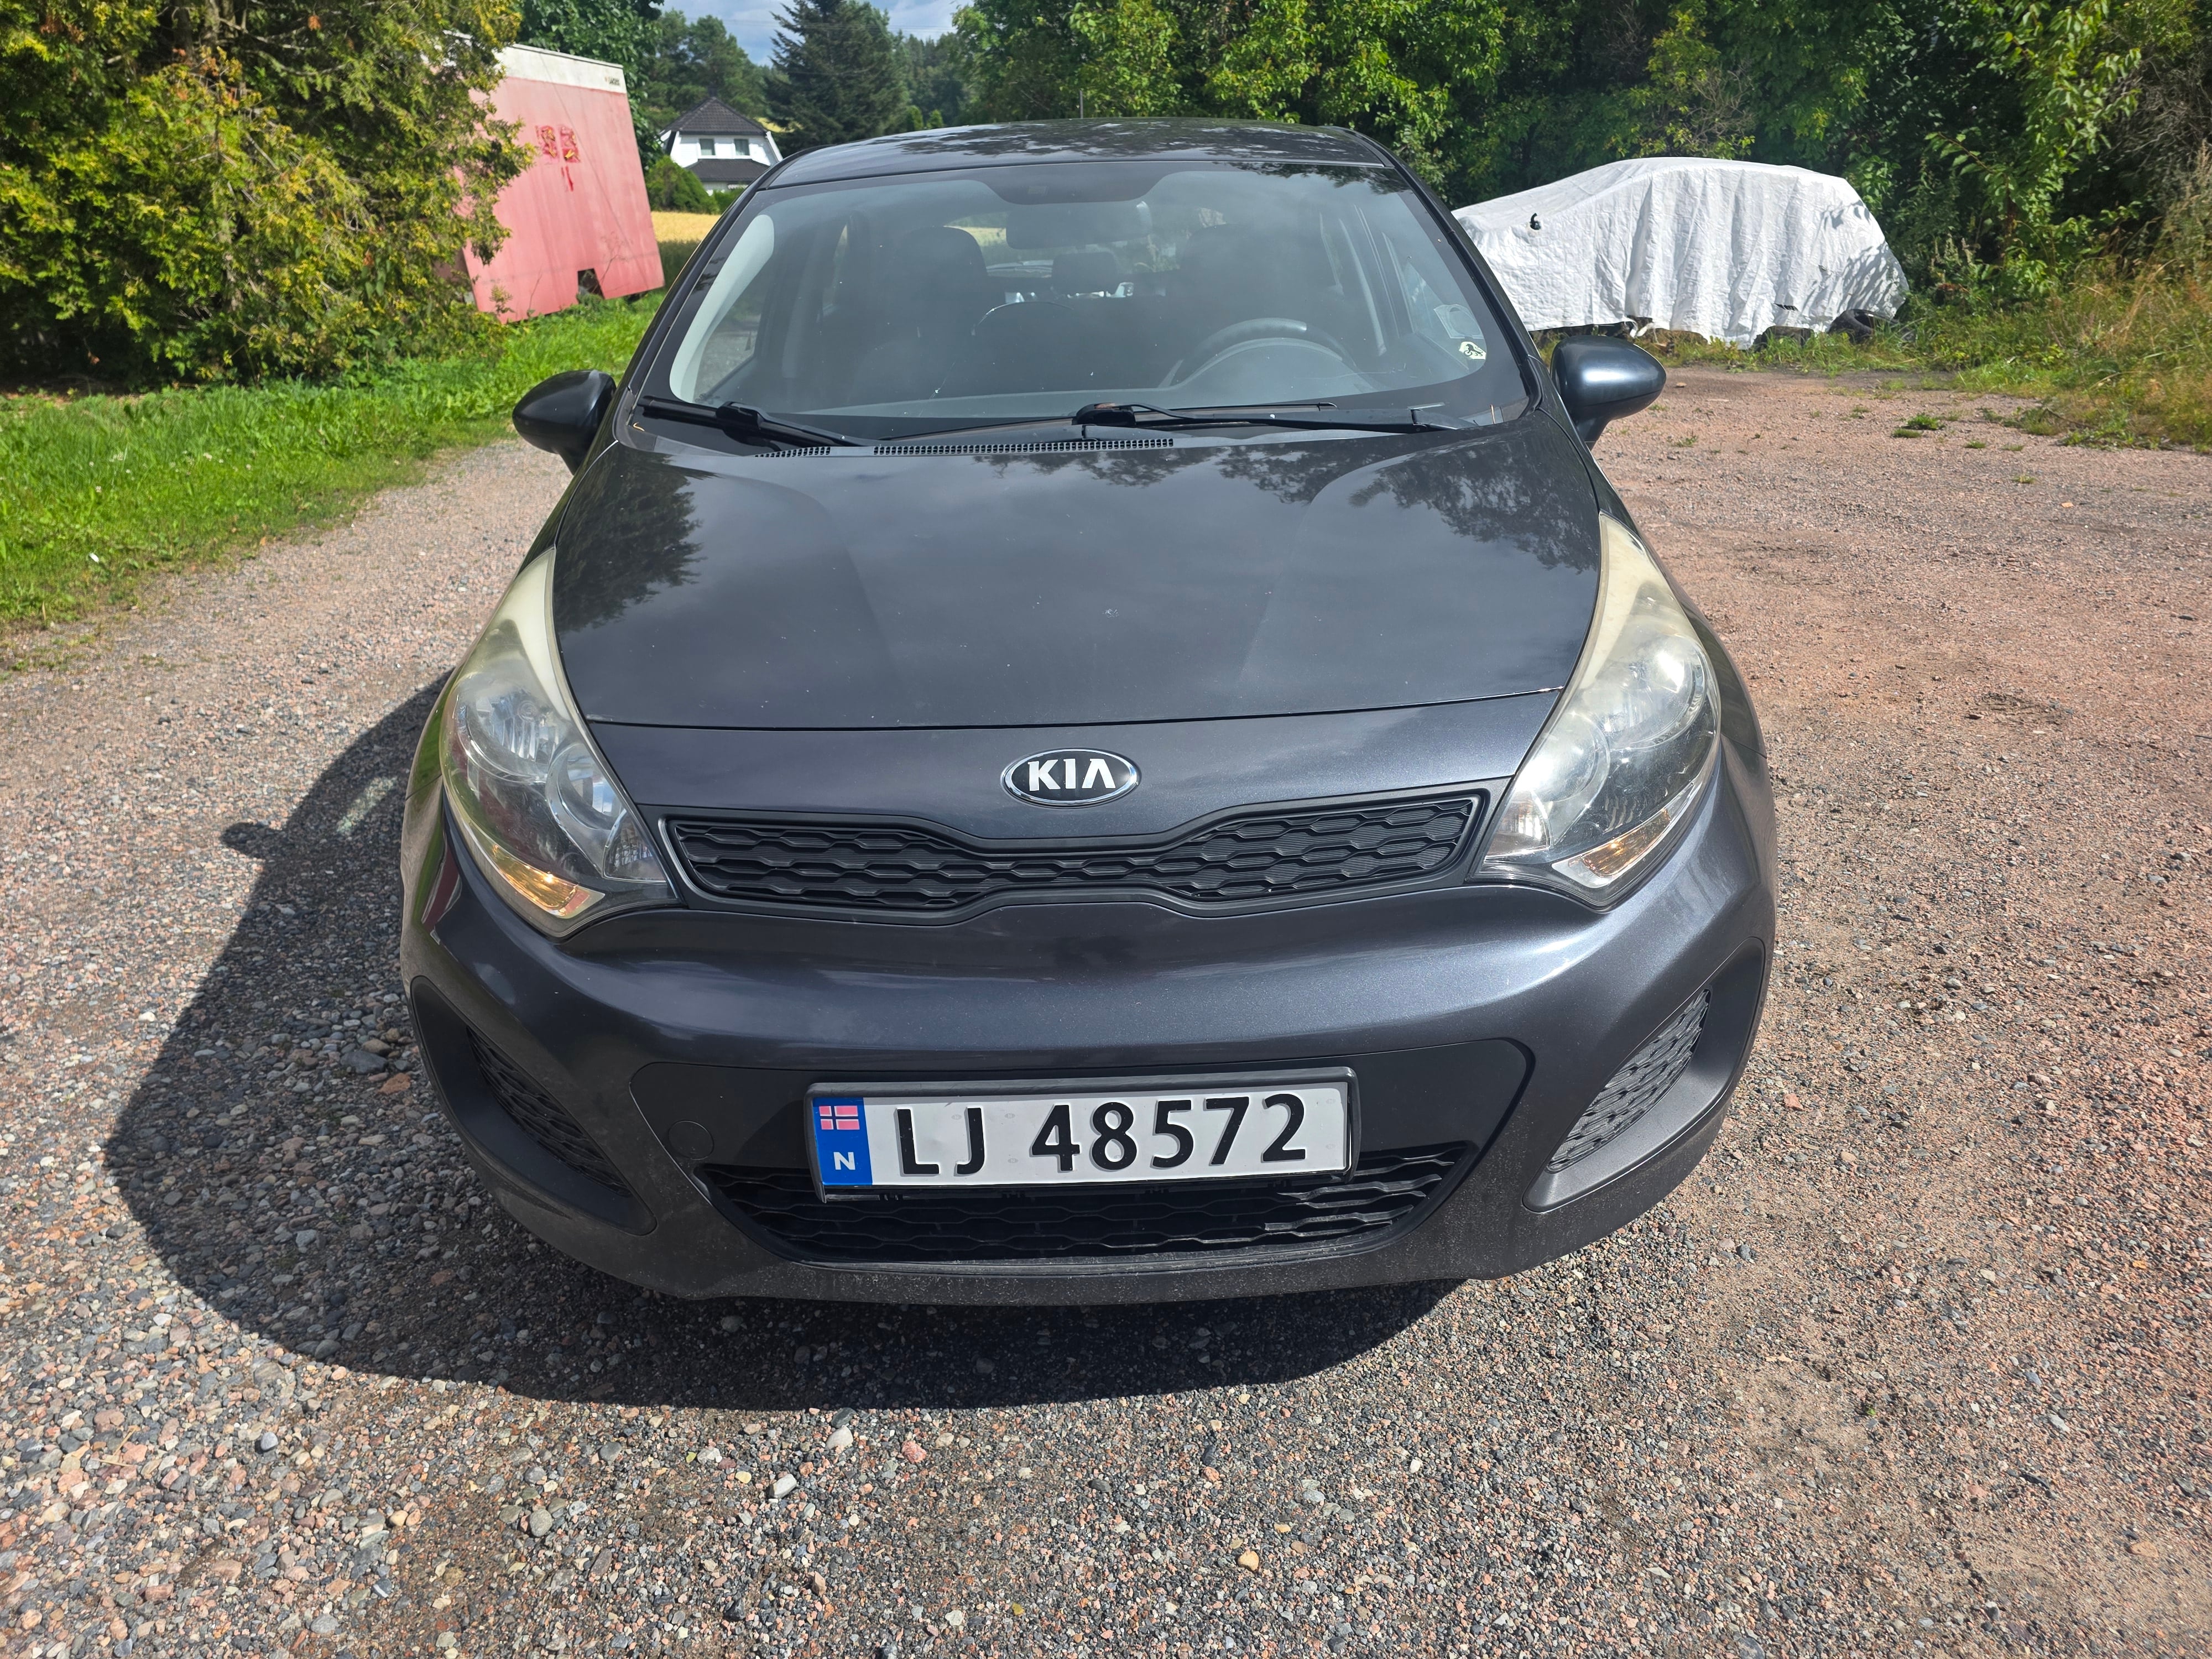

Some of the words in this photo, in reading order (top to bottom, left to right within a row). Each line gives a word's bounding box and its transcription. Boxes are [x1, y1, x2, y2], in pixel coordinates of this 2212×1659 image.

[1027, 758, 1116, 791] KIA
[896, 1107, 985, 1175] LJ
[1031, 1093, 1306, 1171] 48572
[833, 1151, 855, 1170] N
